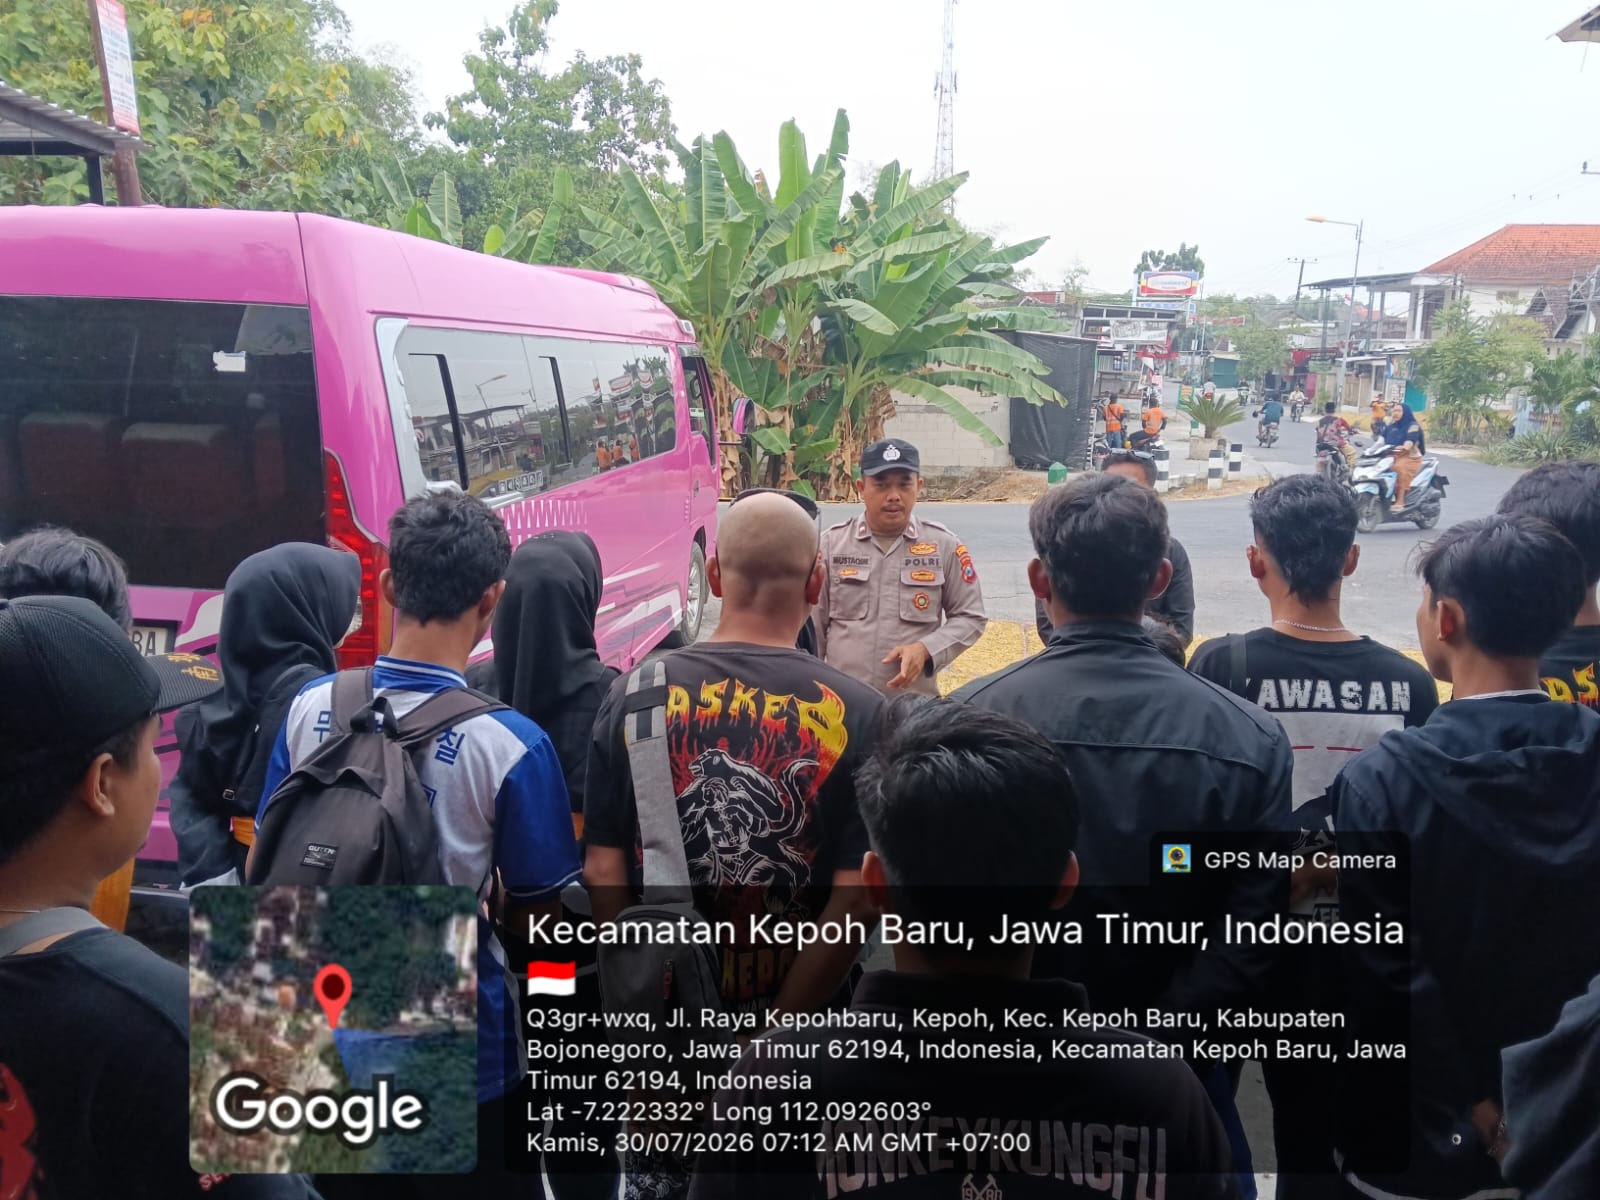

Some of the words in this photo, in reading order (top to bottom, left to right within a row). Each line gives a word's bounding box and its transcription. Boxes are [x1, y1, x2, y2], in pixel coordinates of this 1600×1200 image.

[904, 557, 940, 567] POLRI
[1246, 677, 1411, 712] AWASAN
[815, 1114, 1168, 1200] MONKEYKUNGFU
